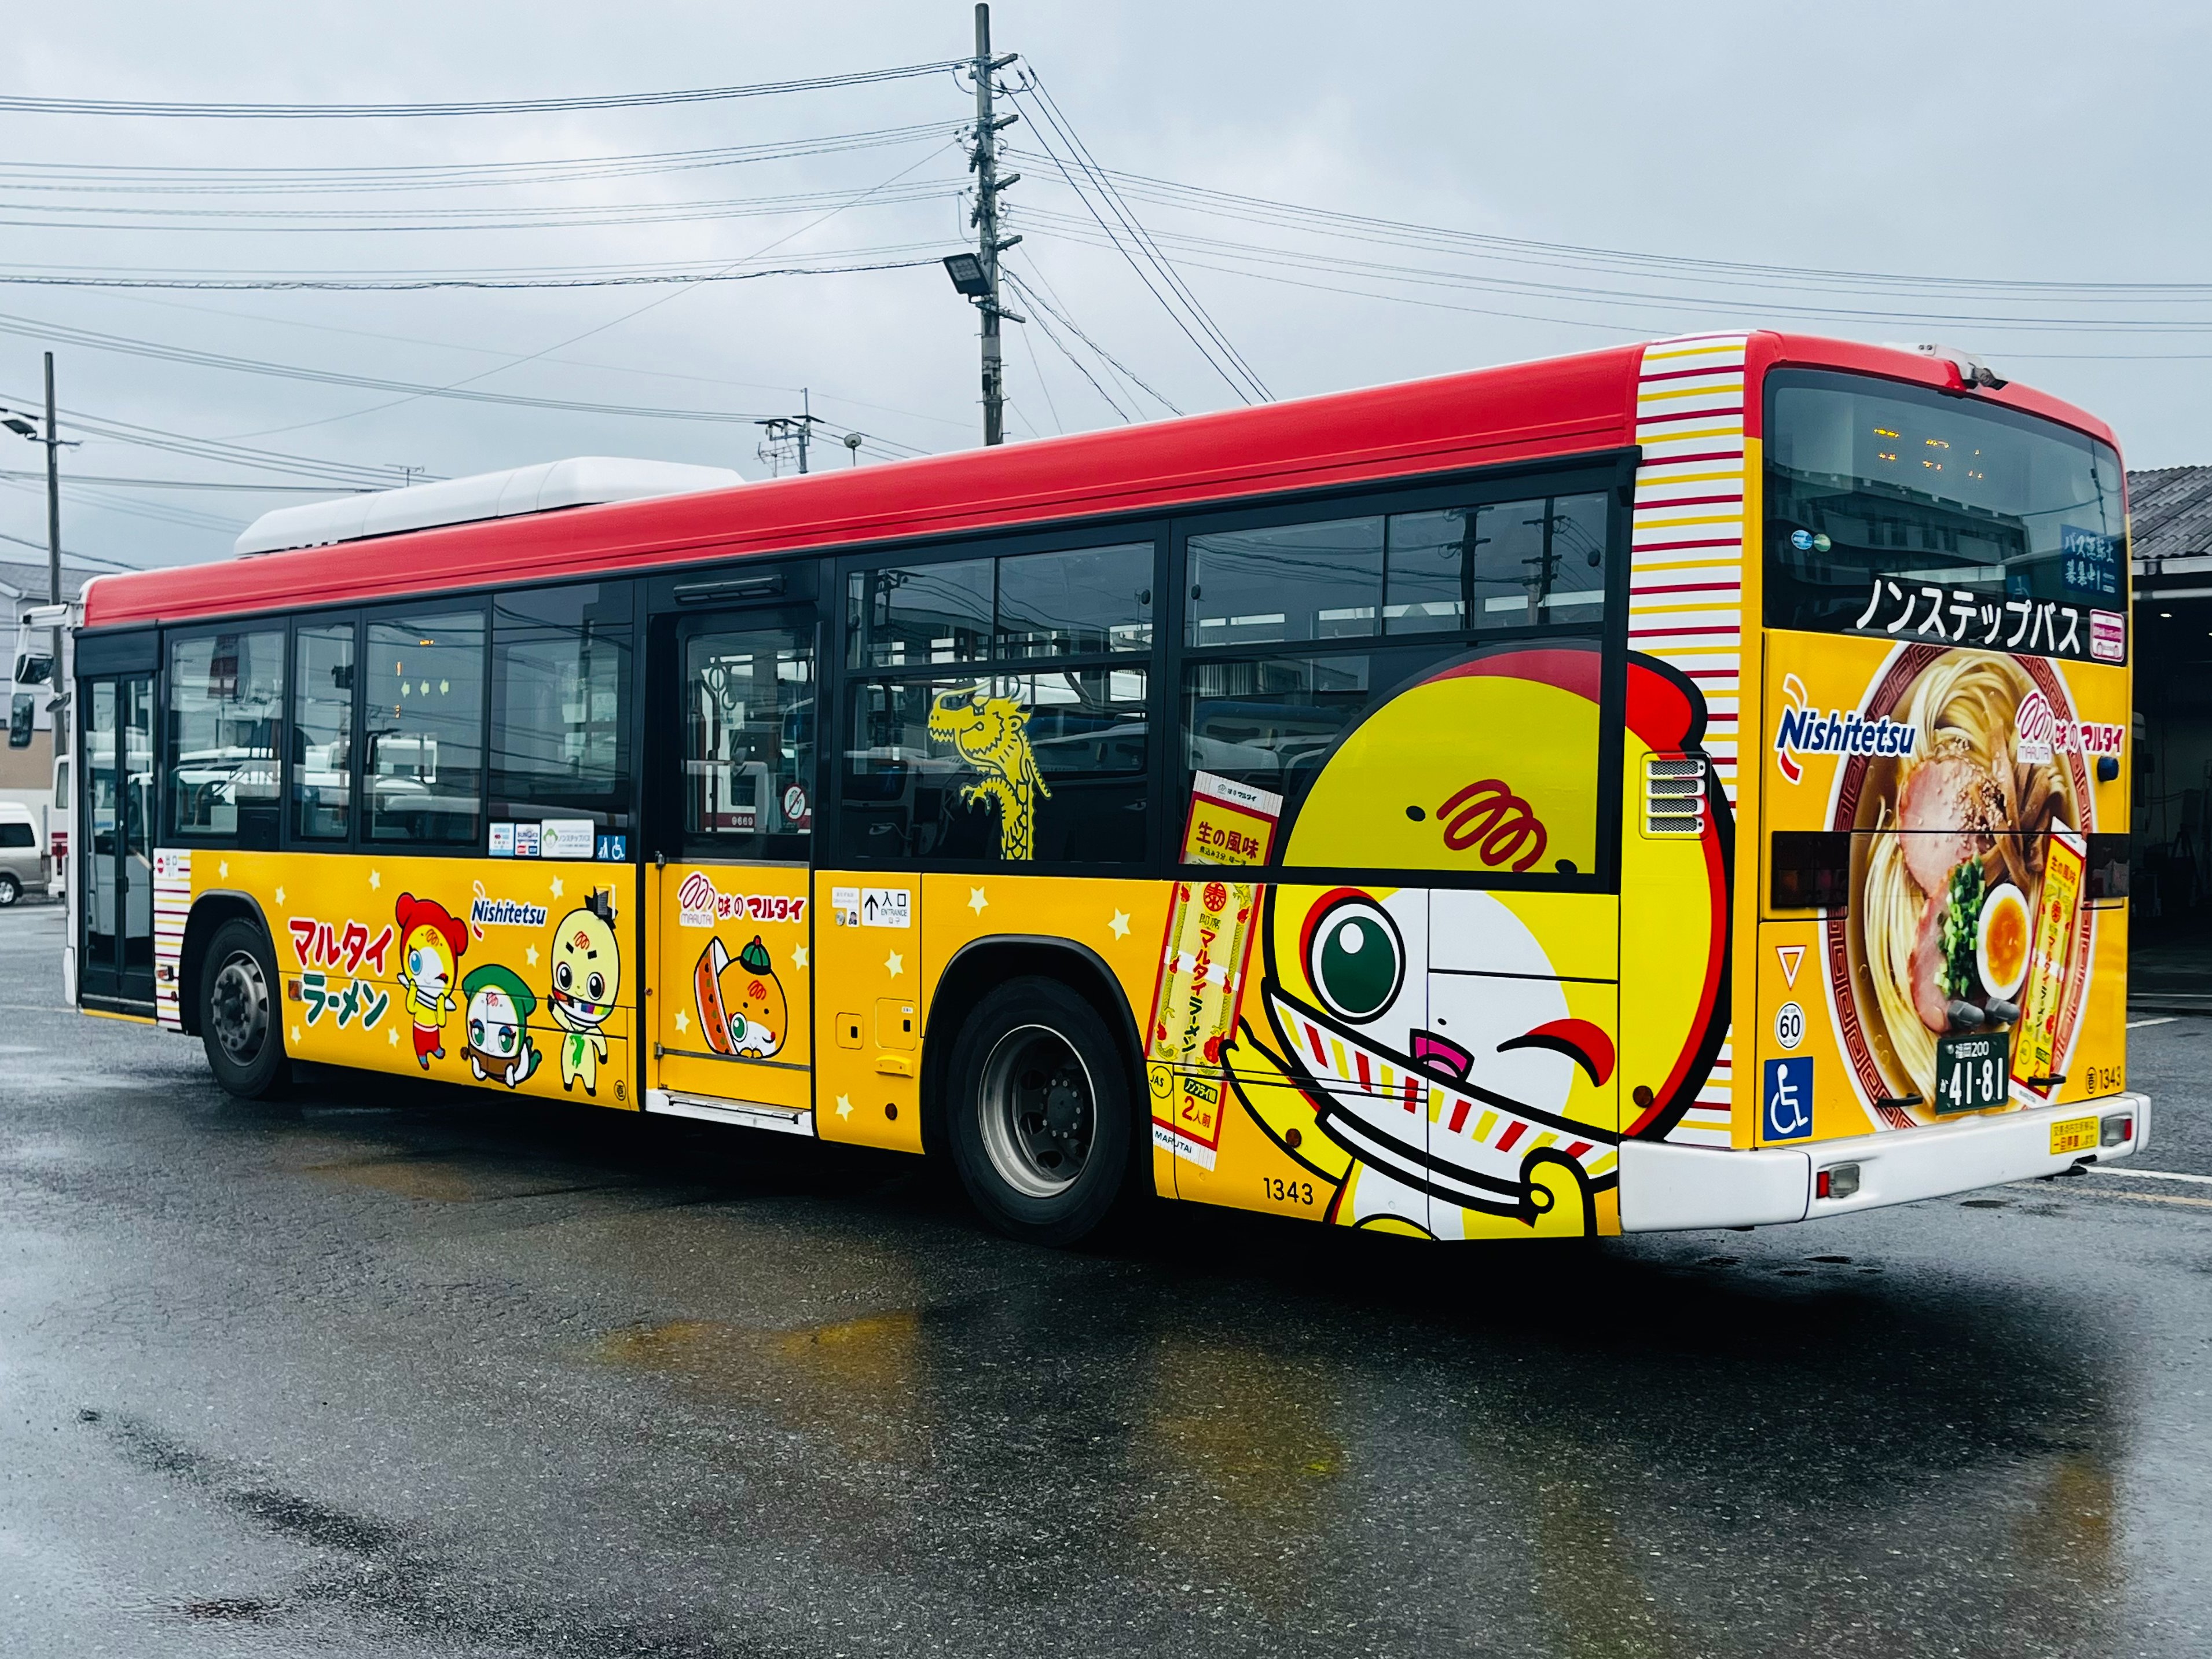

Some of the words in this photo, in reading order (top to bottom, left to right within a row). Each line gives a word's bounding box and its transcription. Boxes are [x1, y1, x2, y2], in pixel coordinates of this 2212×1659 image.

[1856, 579, 2081, 655] ノンステップバス
[1777, 709, 1915, 754] Nishitetsu
[1196, 821, 1259, 860] 生の風味
[718, 896, 804, 920] 味のマルタイ
[882, 891, 906, 906] 入口
[472, 900, 546, 924] Nishitetsu
[681, 913, 713, 925] MARUTAI
[881, 908, 907, 916] ENTRANCE
[289, 920, 392, 973] マルタイ
[303, 974, 388, 1027] ラーメン
[1780, 1014, 1800, 1038] 60
[1150, 1074, 1164, 1087] JAS
[1949, 1057, 2003, 1106] 41-81
[2099, 1066, 2121, 1090] 1343
[1182, 1096, 1212, 1128] 2人前
[1155, 1131, 1193, 1154] MARUTAI
[1263, 1177, 1314, 1205] 1343
